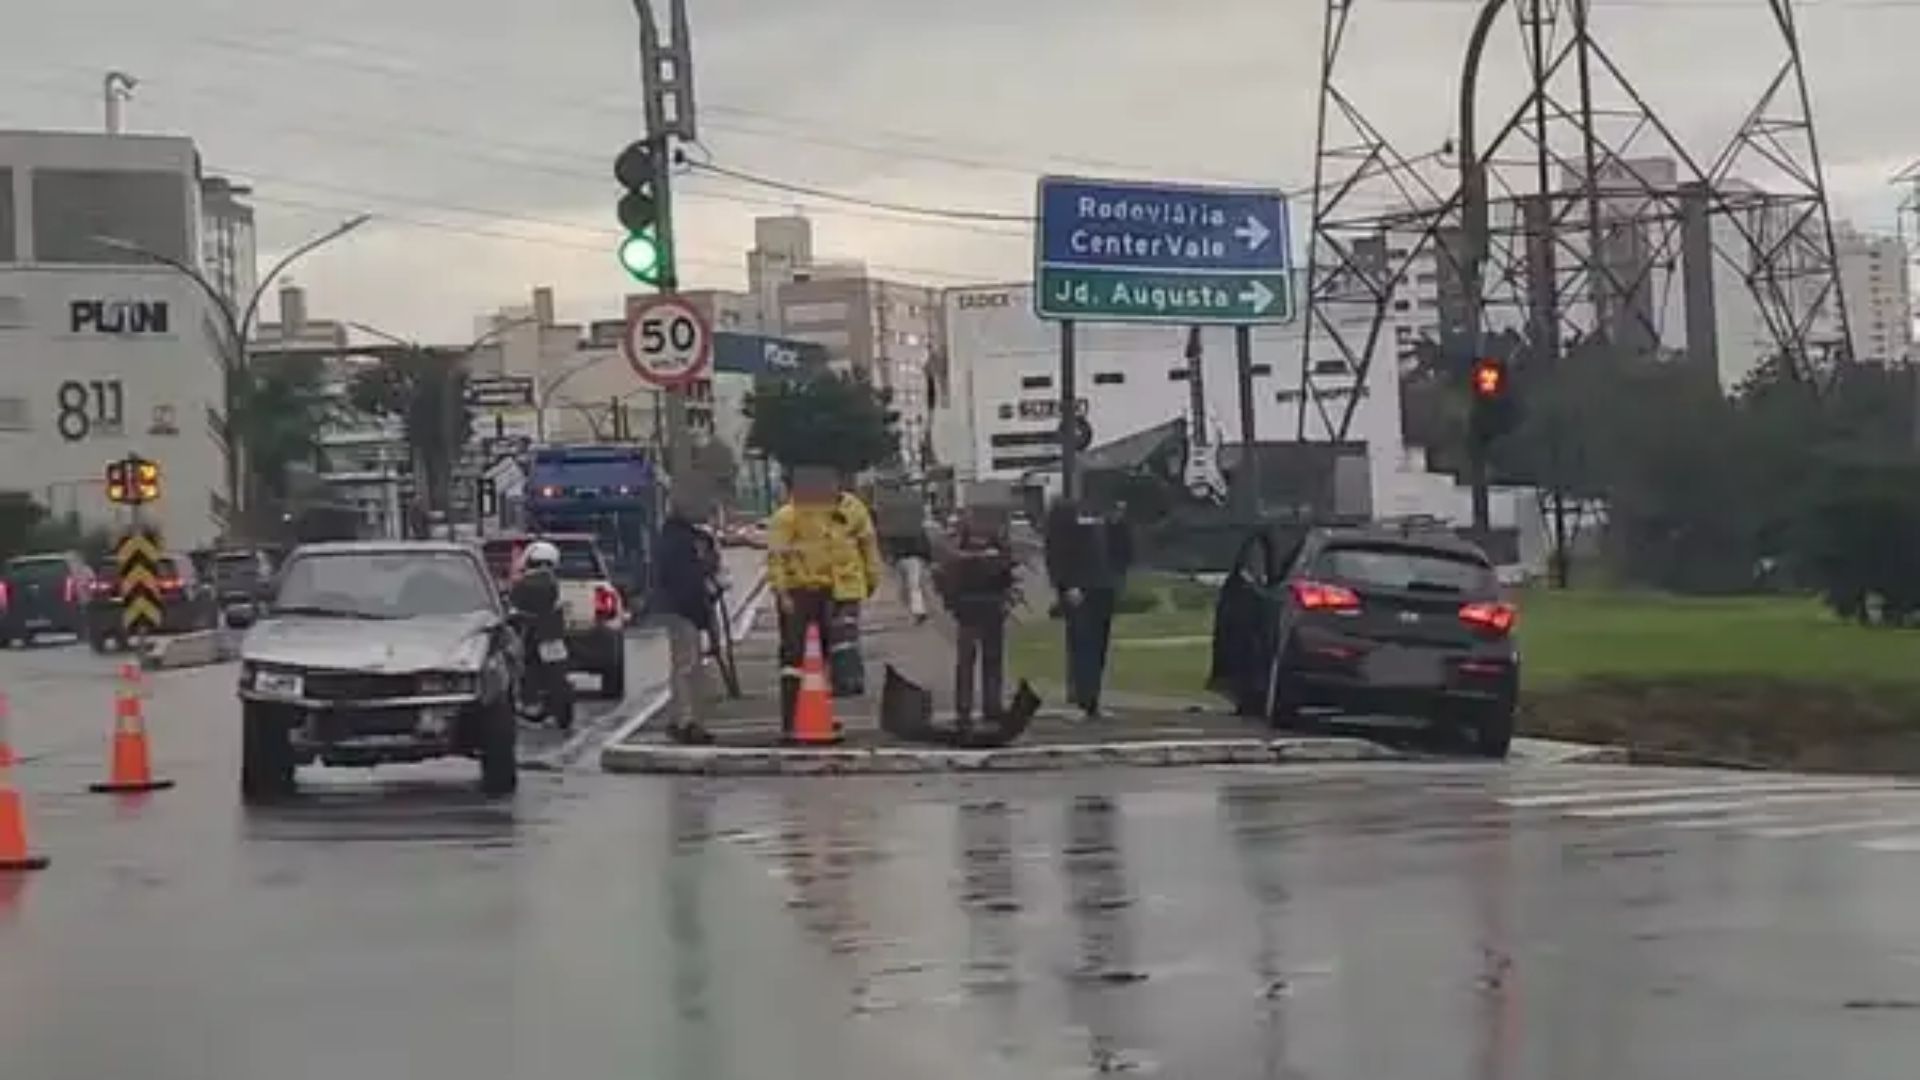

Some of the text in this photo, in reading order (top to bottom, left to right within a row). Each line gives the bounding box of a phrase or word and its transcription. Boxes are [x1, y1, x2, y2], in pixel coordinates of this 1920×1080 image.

[1078, 196, 1225, 225] Rodoviária
[1055, 279, 1230, 311] Jd. Augusta
[642, 315, 696, 354] 50
[57, 379, 123, 442] 811
